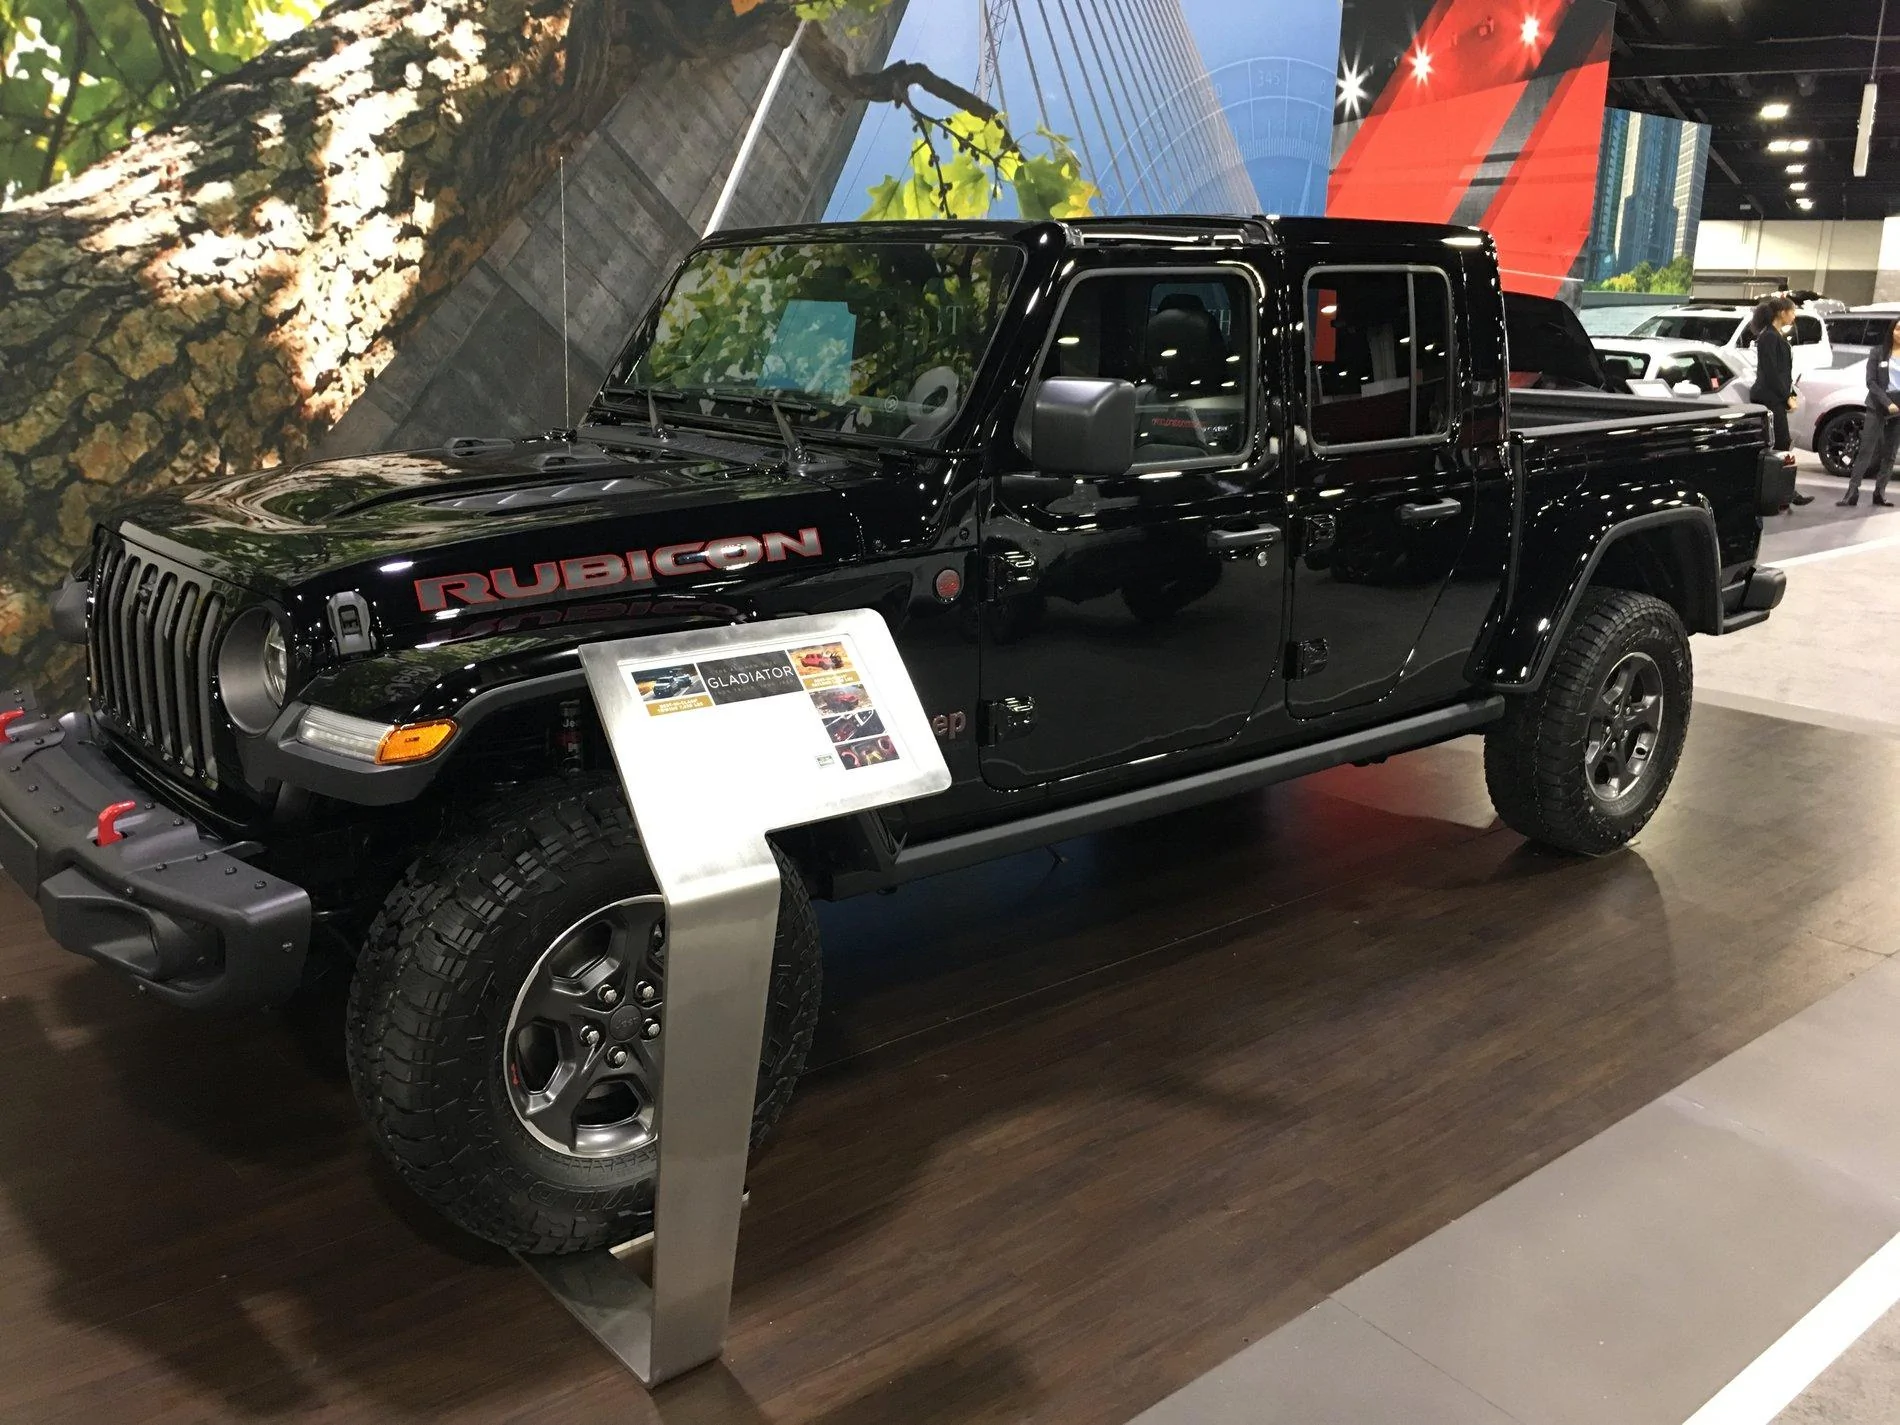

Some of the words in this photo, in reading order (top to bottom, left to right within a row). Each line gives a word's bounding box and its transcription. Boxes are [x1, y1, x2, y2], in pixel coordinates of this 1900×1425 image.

[413, 527, 823, 612] RUBICON
[707, 665, 794, 689] GLADIATOR
[932, 710, 966, 740] ep
